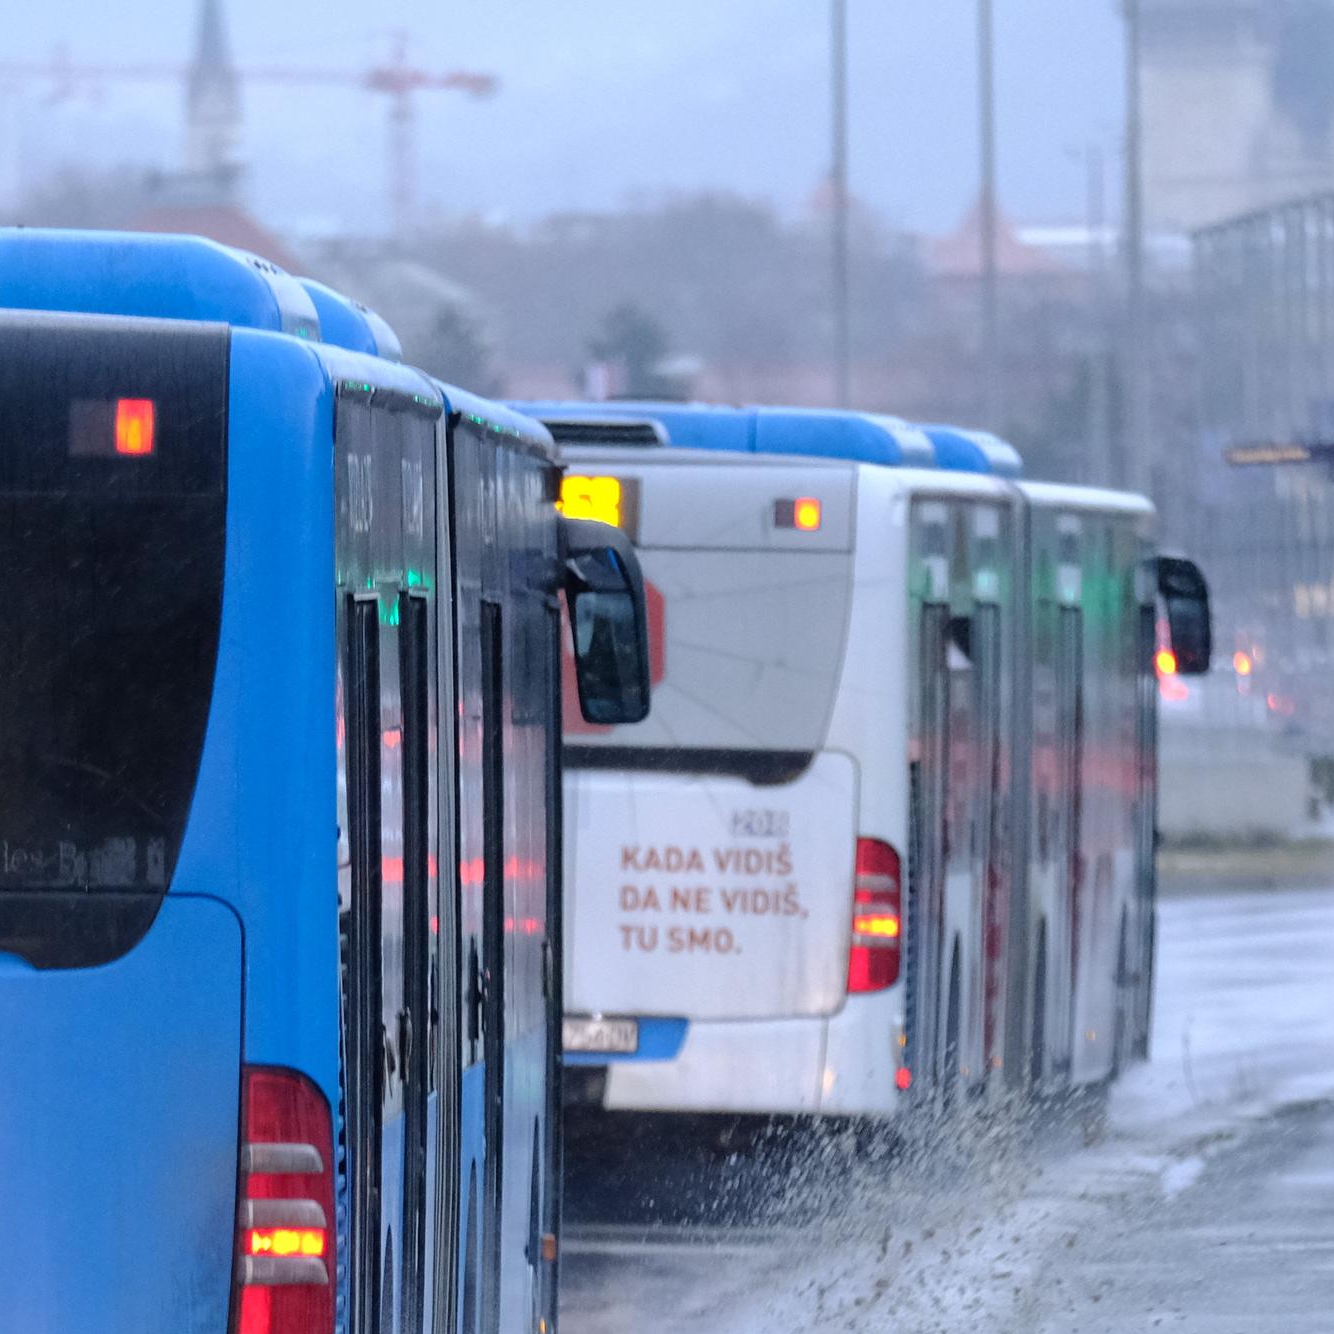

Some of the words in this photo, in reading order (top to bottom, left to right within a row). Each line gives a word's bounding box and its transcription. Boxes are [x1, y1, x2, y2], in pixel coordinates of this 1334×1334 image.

[620, 847, 705, 873] KADA
[713, 842, 793, 875] VIDIŠ
[620, 885, 662, 913] DA
[670, 886, 712, 914] NE
[720, 883, 809, 920] VIDIŠ,
[619, 925, 658, 952] TU
[667, 927, 742, 955] SMO.
